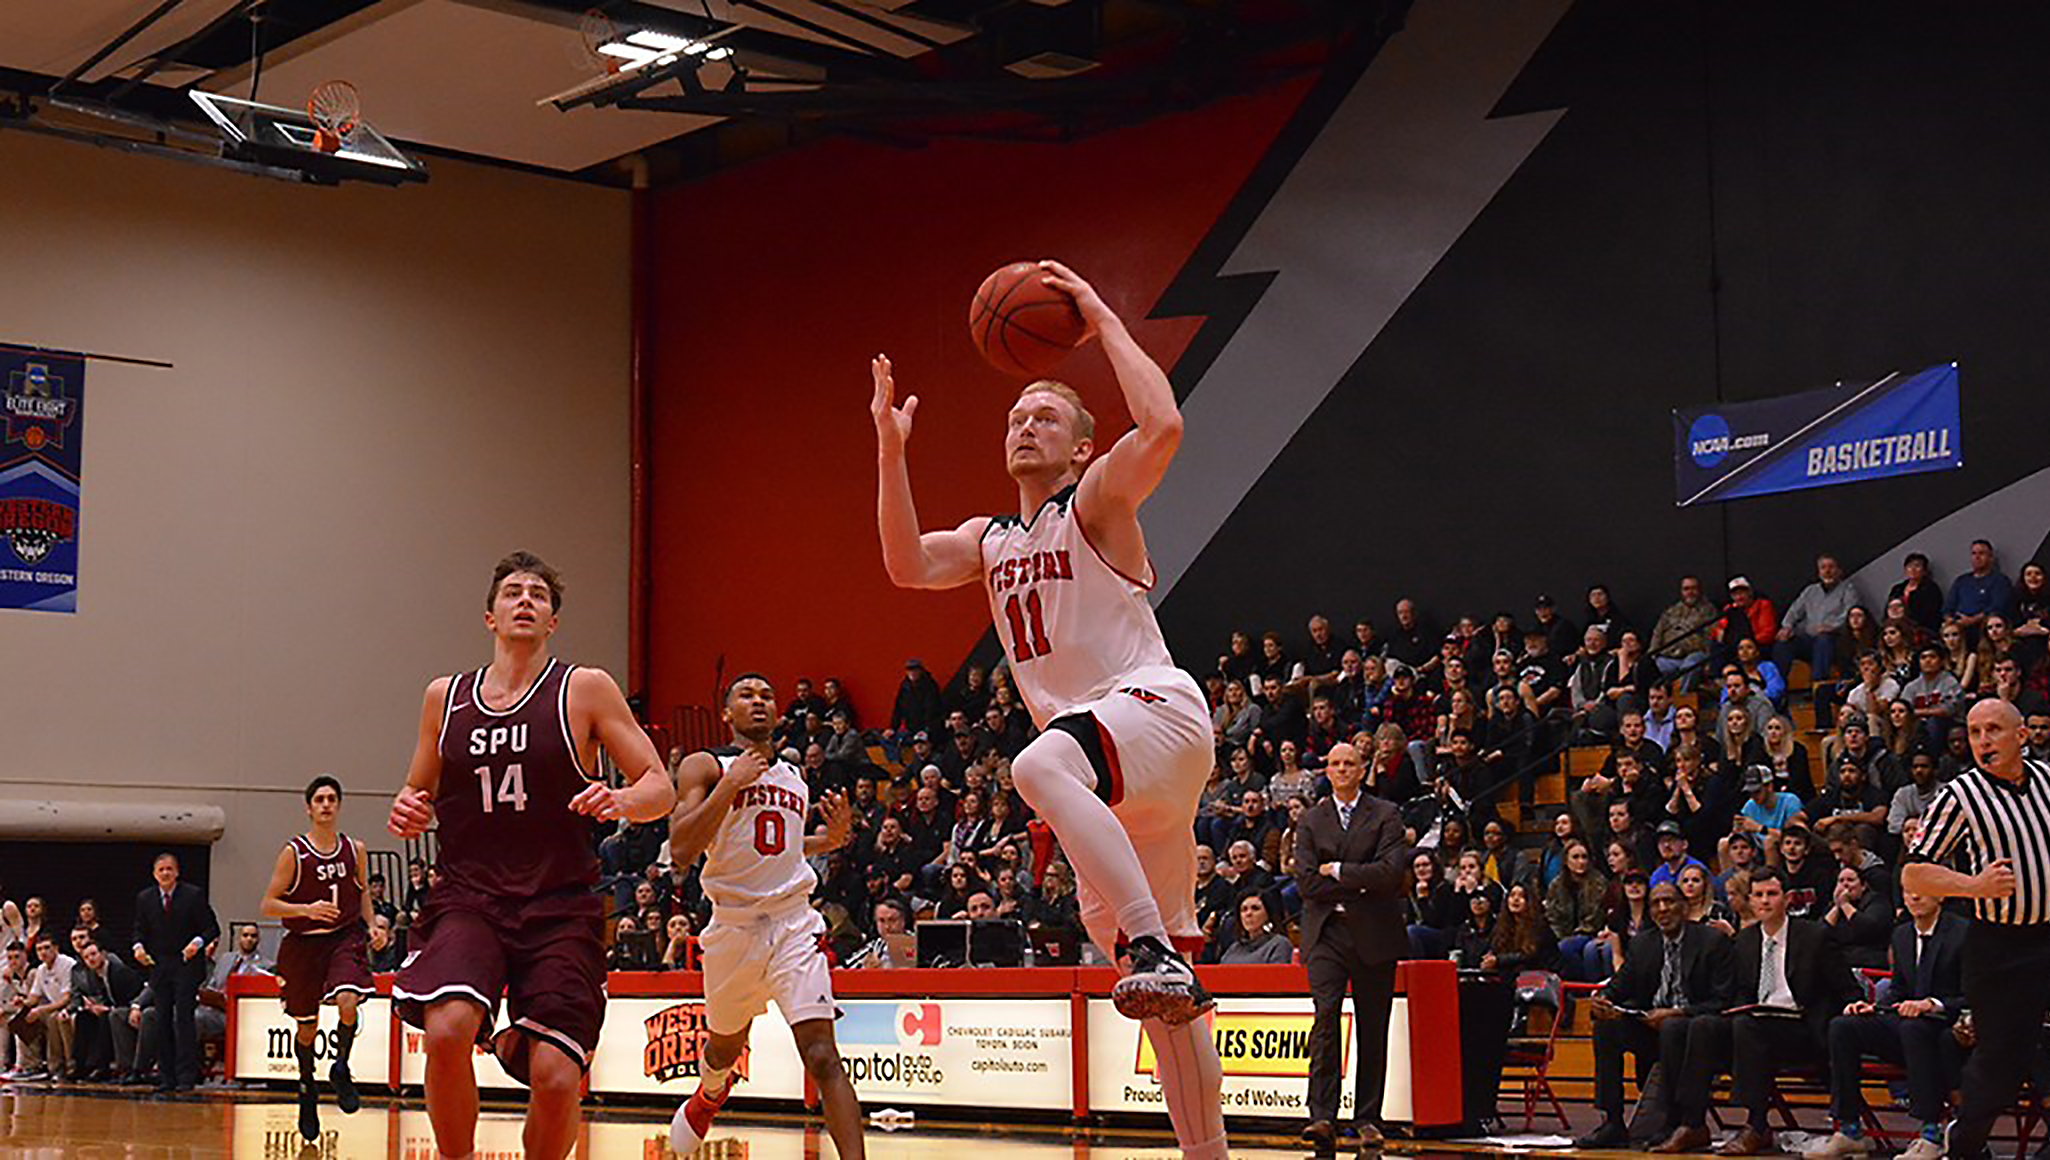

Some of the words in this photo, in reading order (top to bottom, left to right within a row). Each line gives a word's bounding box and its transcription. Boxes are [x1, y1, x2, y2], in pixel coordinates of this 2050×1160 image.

[1692, 433, 1769, 455] NCAA.com
[1807, 429, 1951, 476] BASKETBALL
[35, 571, 74, 585] OREGON
[990, 550, 1073, 592] ESTERN
[1005, 588, 1051, 663] 11
[469, 723, 528, 755] SPU
[474, 763, 528, 813] 14
[732, 783, 804, 818] WESTERN
[754, 810, 785, 856] 0
[316, 862, 347, 881] SPU
[328, 883, 338, 908] 1
[644, 1003, 707, 1041] WEST
[947, 1026, 993, 1037] CHEVROLET
[997, 1027, 1036, 1037] CADILLAC
[976, 1039, 1007, 1049] TOYOTA
[1012, 1040, 1038, 1050] SCION
[1216, 1029, 1247, 1058] LES
[1251, 1029, 1311, 1059] SCHW
[840, 1053, 900, 1085] apitol
[903, 1055, 932, 1069] auto
[971, 1058, 1048, 1075] capitolauto.com
[903, 1069, 944, 1087] group
[1124, 1086, 1163, 1103] Proud
[1235, 1089, 1249, 1106] of
[1252, 1090, 1301, 1108] Wolves
